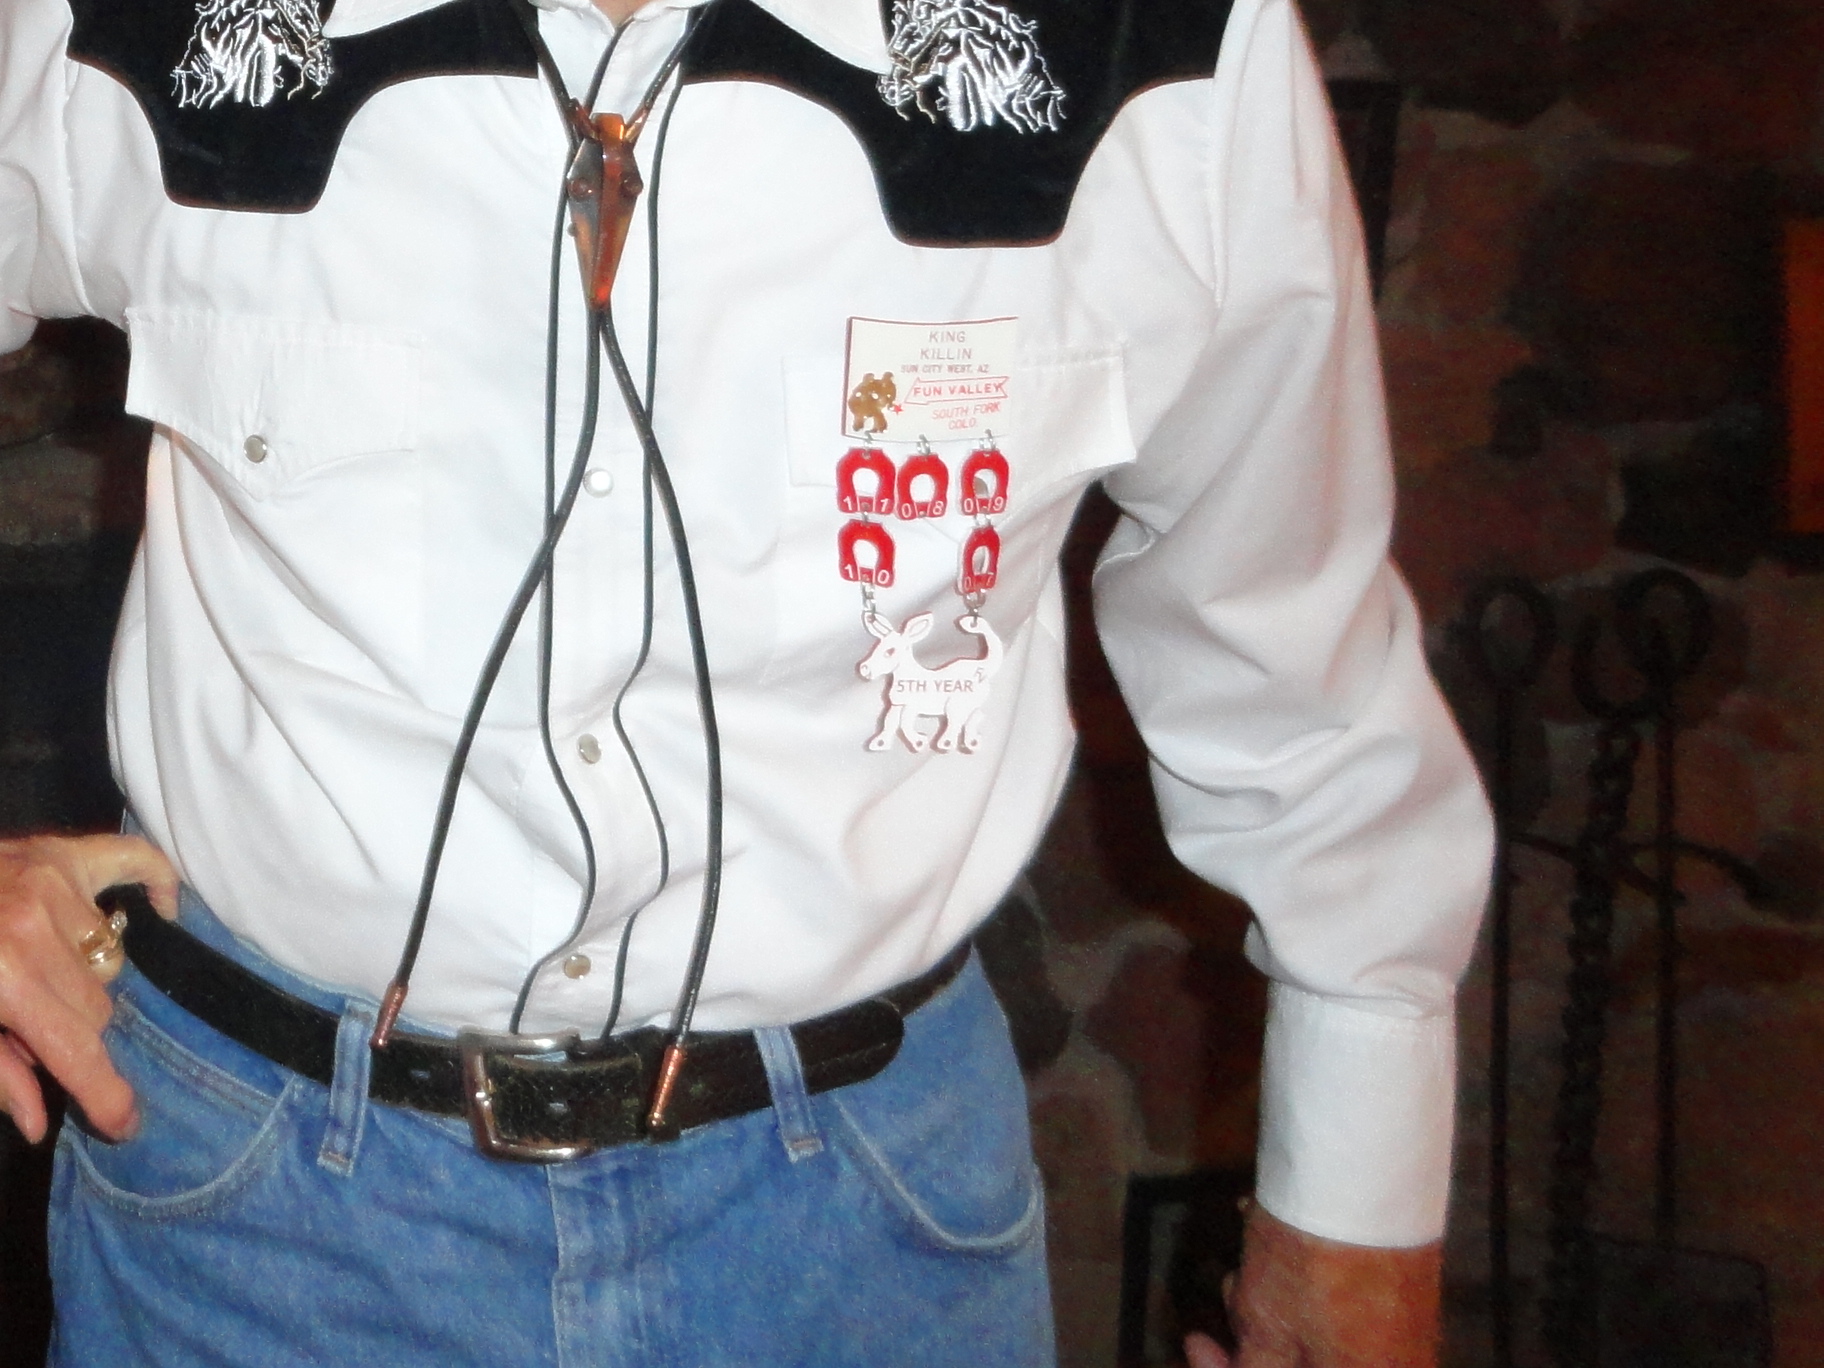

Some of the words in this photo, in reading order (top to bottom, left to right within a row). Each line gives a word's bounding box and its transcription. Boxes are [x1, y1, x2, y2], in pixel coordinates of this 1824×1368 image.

[928, 331, 966, 343] KING
[920, 348, 972, 360] KILLIN
[901, 364, 919, 374] SUN
[922, 364, 943, 374] CITY
[977, 364, 989, 373] AZ
[913, 386, 943, 397] FUN
[949, 383, 1001, 395] VALLEY
[932, 405, 968, 420] SOUTH
[971, 401, 1001, 415] FORK
[901, 500, 944, 518] 08
[963, 496, 1004, 513] 09
[845, 564, 890, 585] 10
[897, 679, 927, 693] 5TH
[934, 679, 974, 693] YEAR
